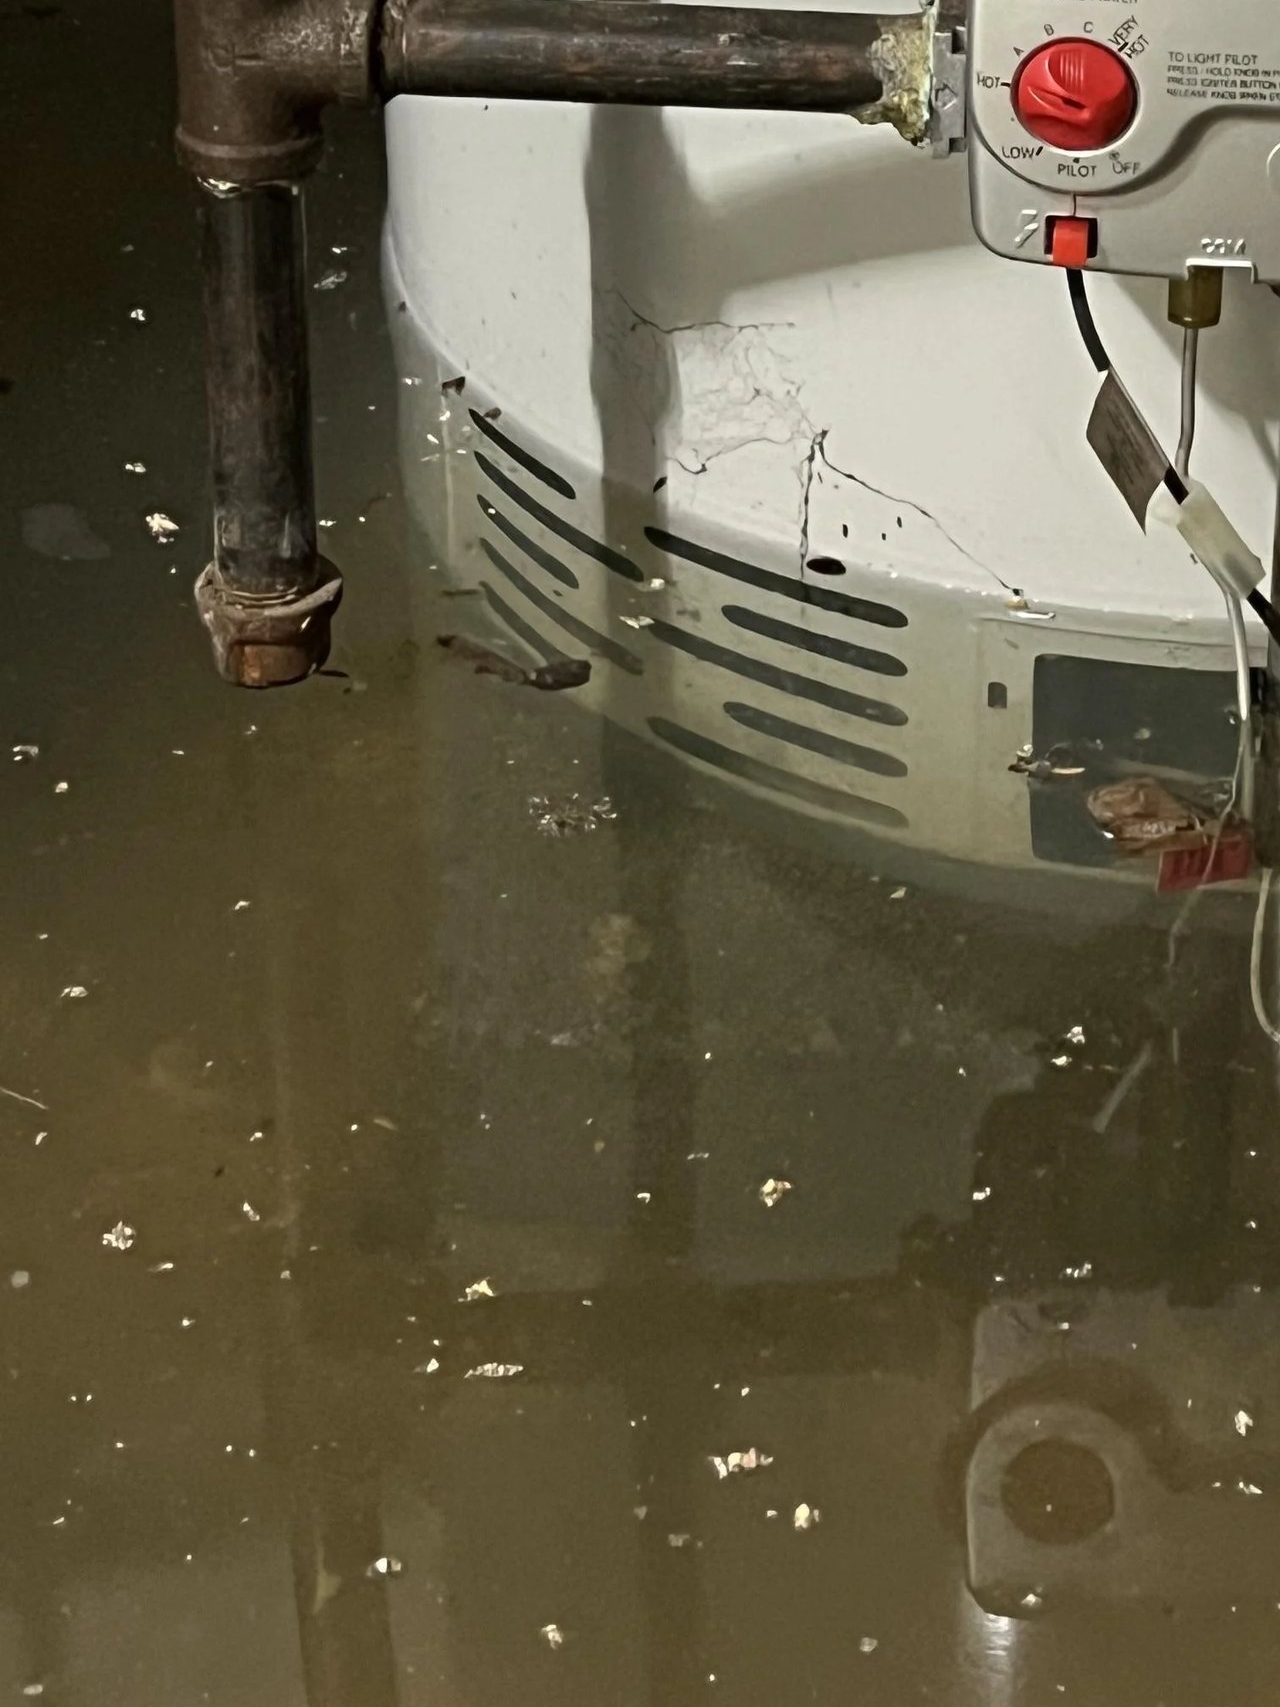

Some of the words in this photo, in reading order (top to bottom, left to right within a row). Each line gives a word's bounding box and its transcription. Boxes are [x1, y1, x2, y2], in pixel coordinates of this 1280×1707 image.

[1083, 22, 1093, 33] C
[1108, 15, 1138, 45] VERY
[1125, 34, 1150, 58] HOT
[1013, 46, 1024, 57] A
[1168, 51, 1184, 62] TO
[1187, 53, 1220, 63] LIGHT
[1224, 53, 1257, 65] PILOT
[976, 71, 1000, 88] HOT
[1001, 146, 1035, 160] LOW
[1057, 163, 1097, 177] PILOT
[1112, 162, 1141, 175] OFF
